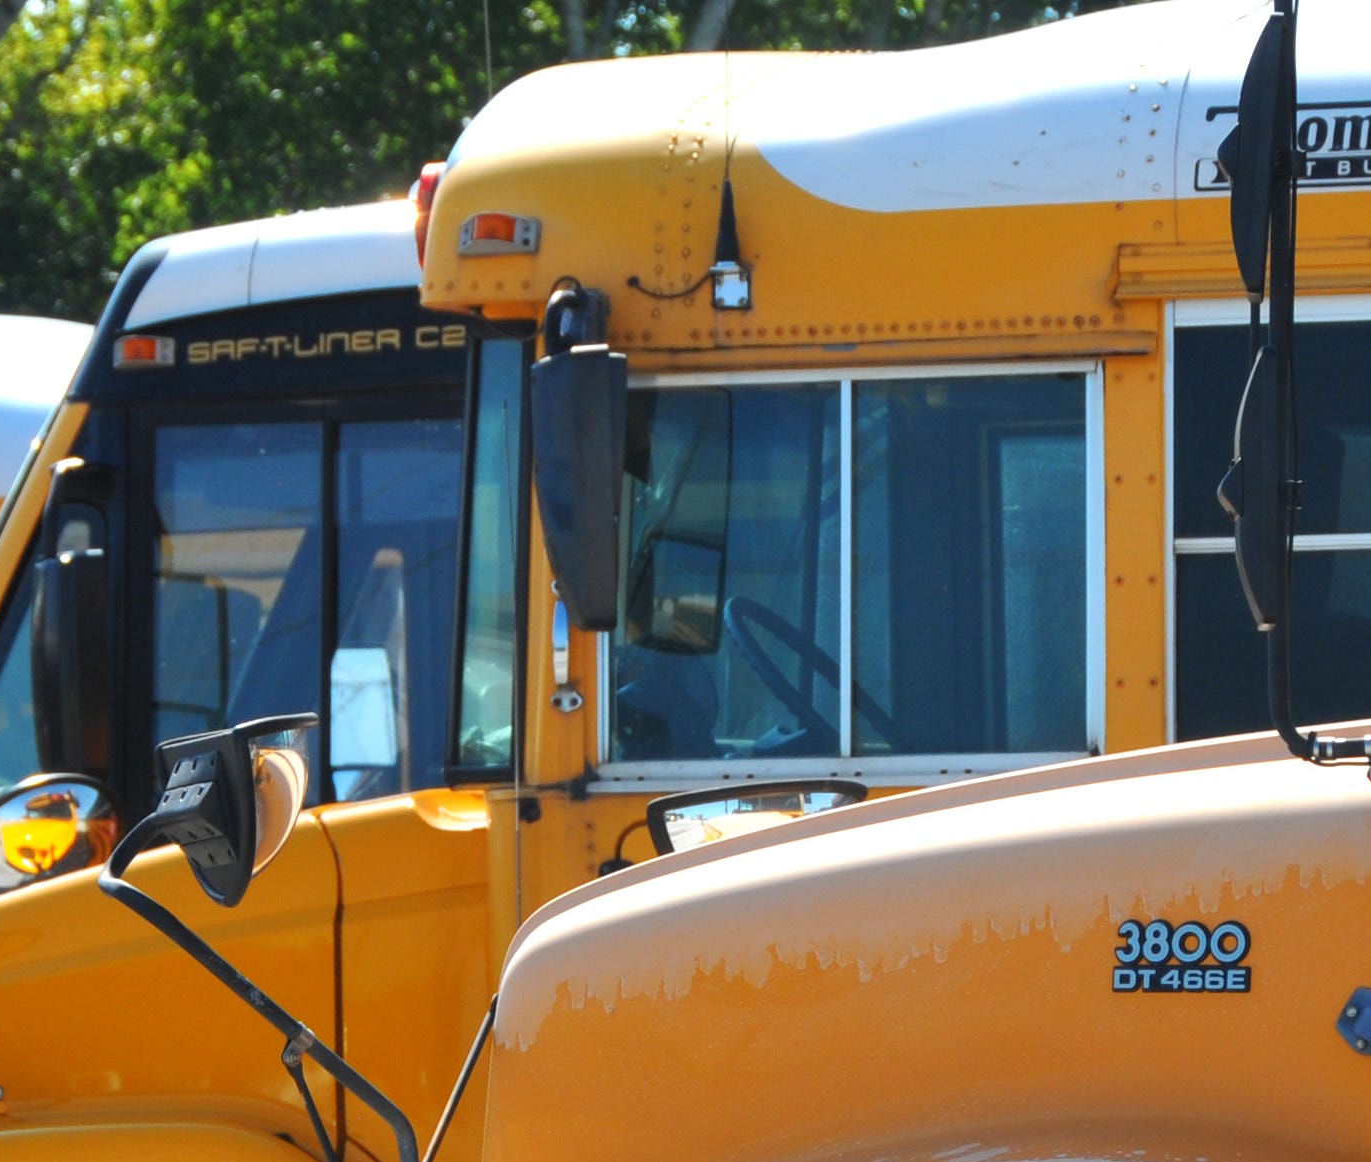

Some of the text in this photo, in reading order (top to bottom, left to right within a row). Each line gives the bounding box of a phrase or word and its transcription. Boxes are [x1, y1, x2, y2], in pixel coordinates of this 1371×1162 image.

[187, 325, 466, 363] SAF-T-LINER C2
[1115, 920, 1250, 964] 3800
[1113, 969, 1247, 989] DT 466E
